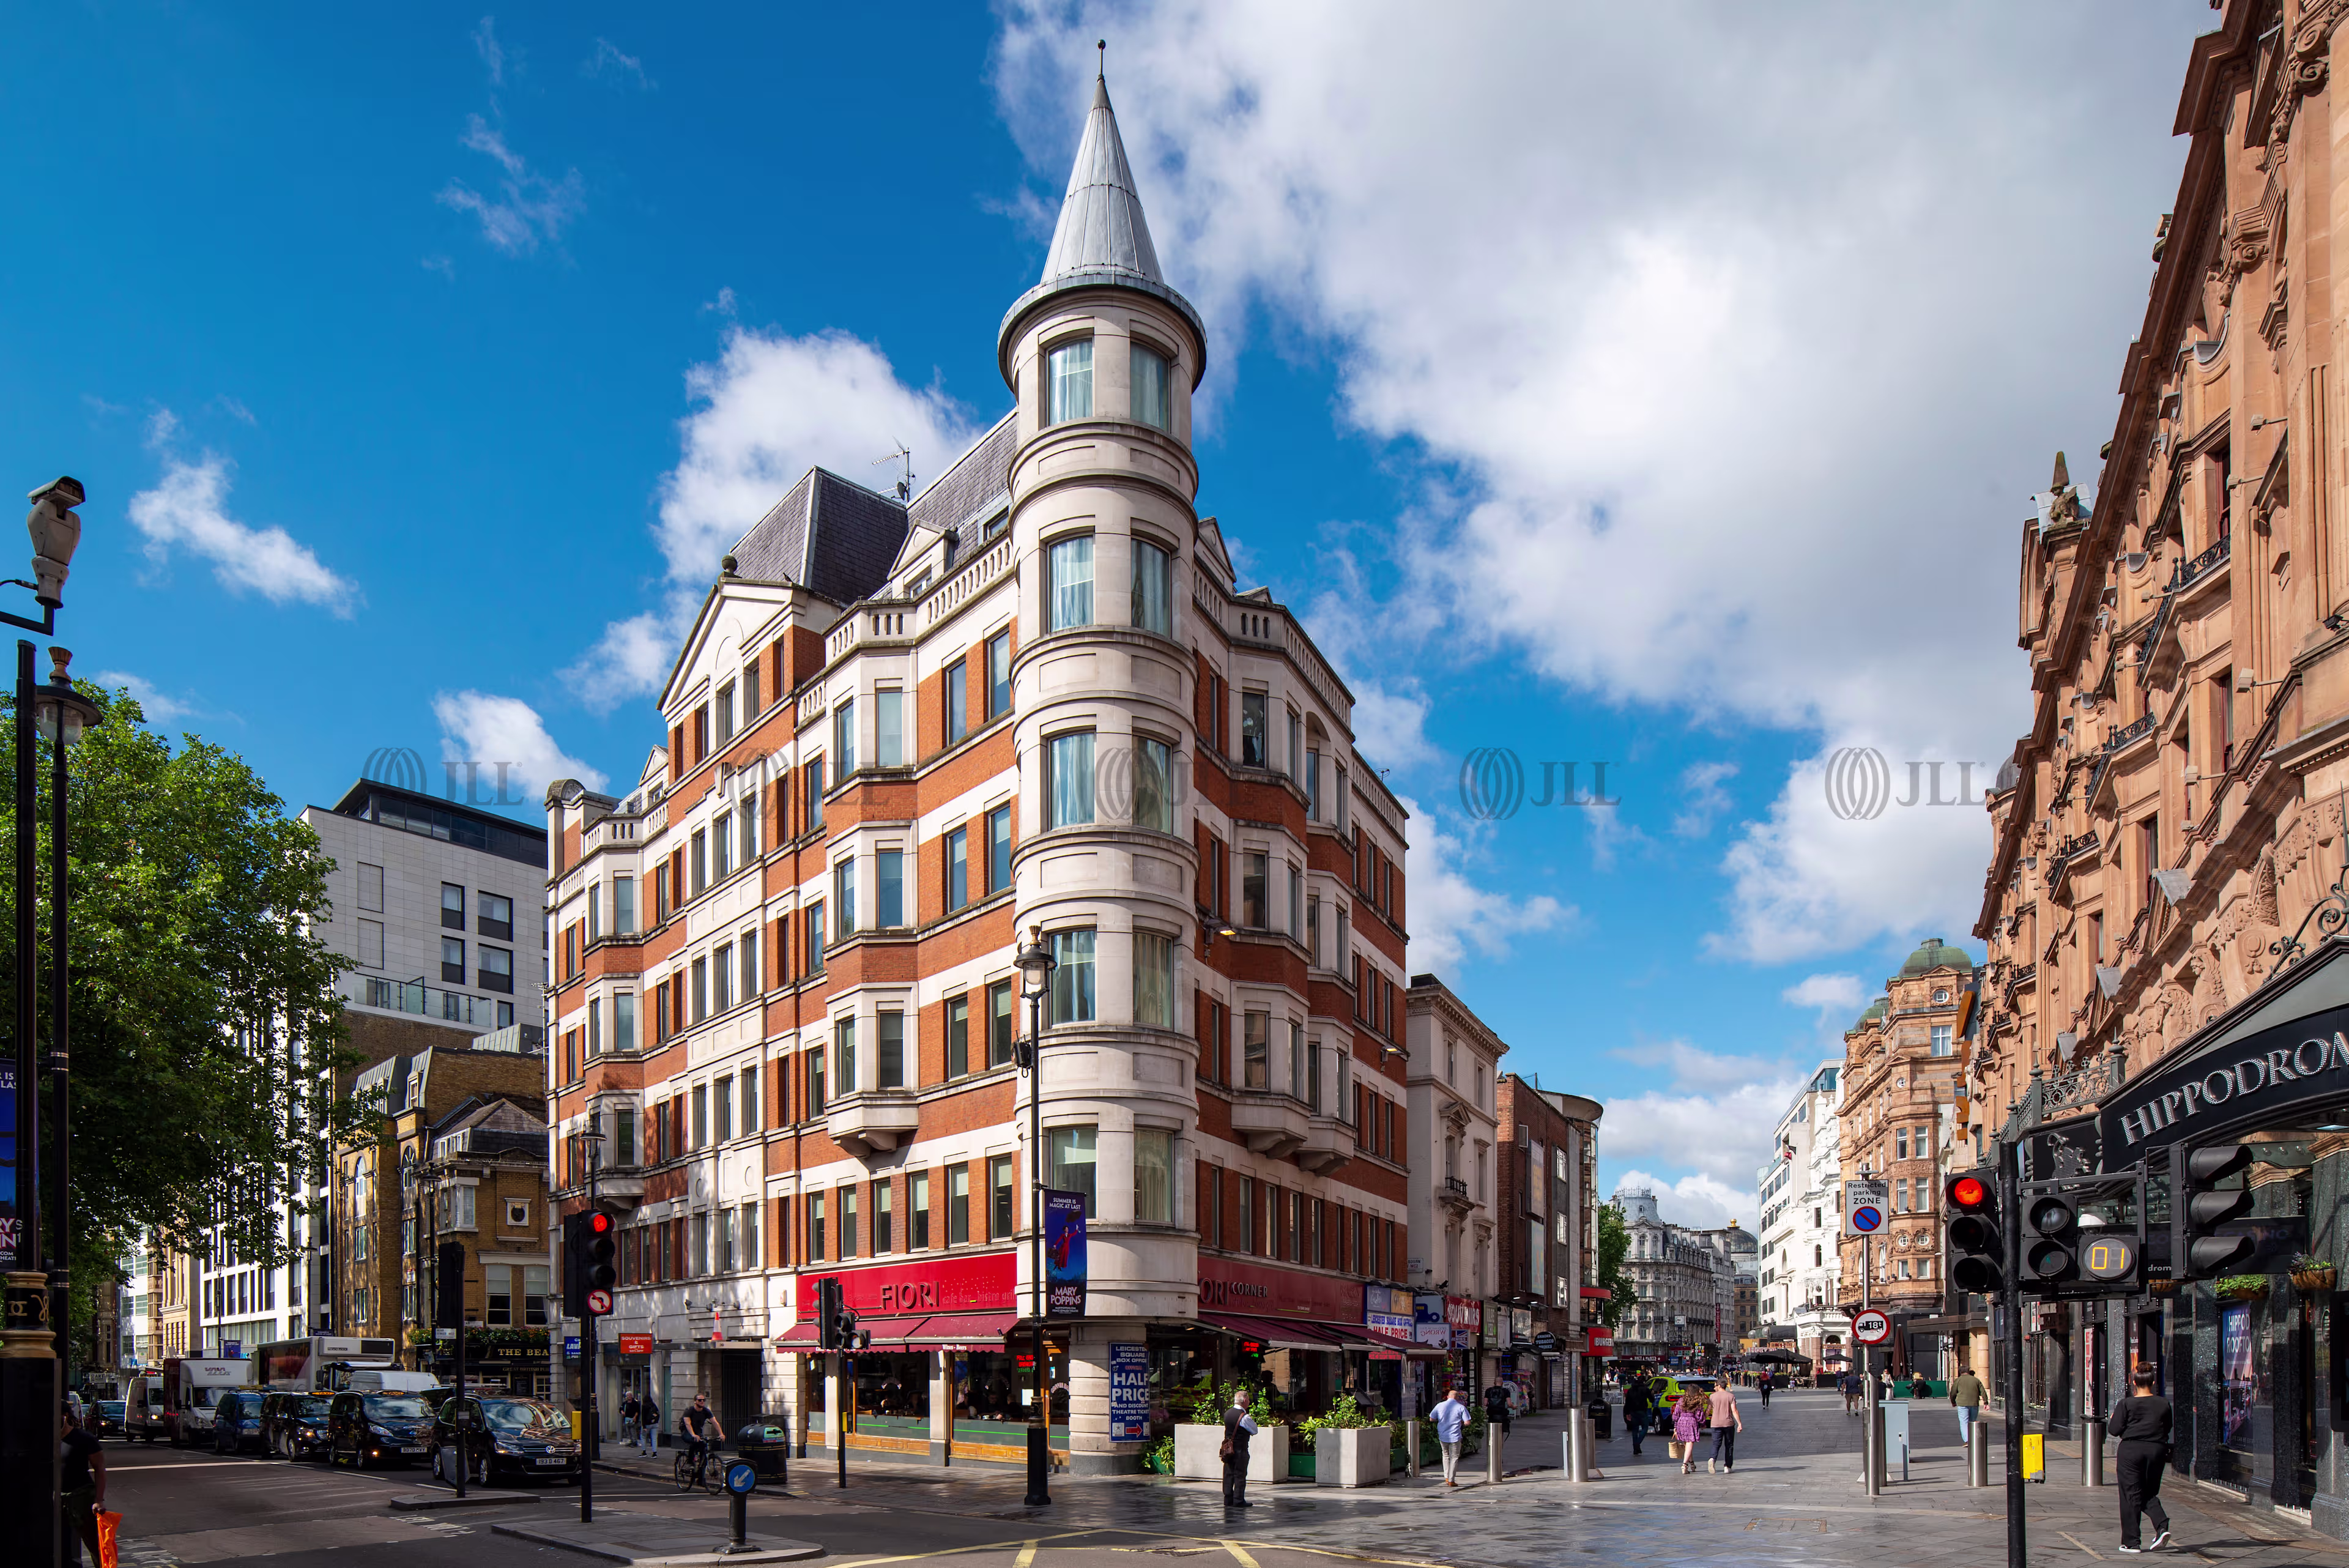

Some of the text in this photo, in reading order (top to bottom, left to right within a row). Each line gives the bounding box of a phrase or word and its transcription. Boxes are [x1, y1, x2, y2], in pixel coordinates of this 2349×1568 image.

[880, 1280, 940, 1309] FIORI
[1055, 1286, 1077, 1296] MARY
[1232, 1282, 1267, 1298] CORNER
[1050, 1295, 1082, 1306] POPPINS
[1391, 1328, 1408, 1339] PRICE
[1113, 1372, 1148, 1386] HALF
[1111, 1388, 1149, 1401] PRICE
